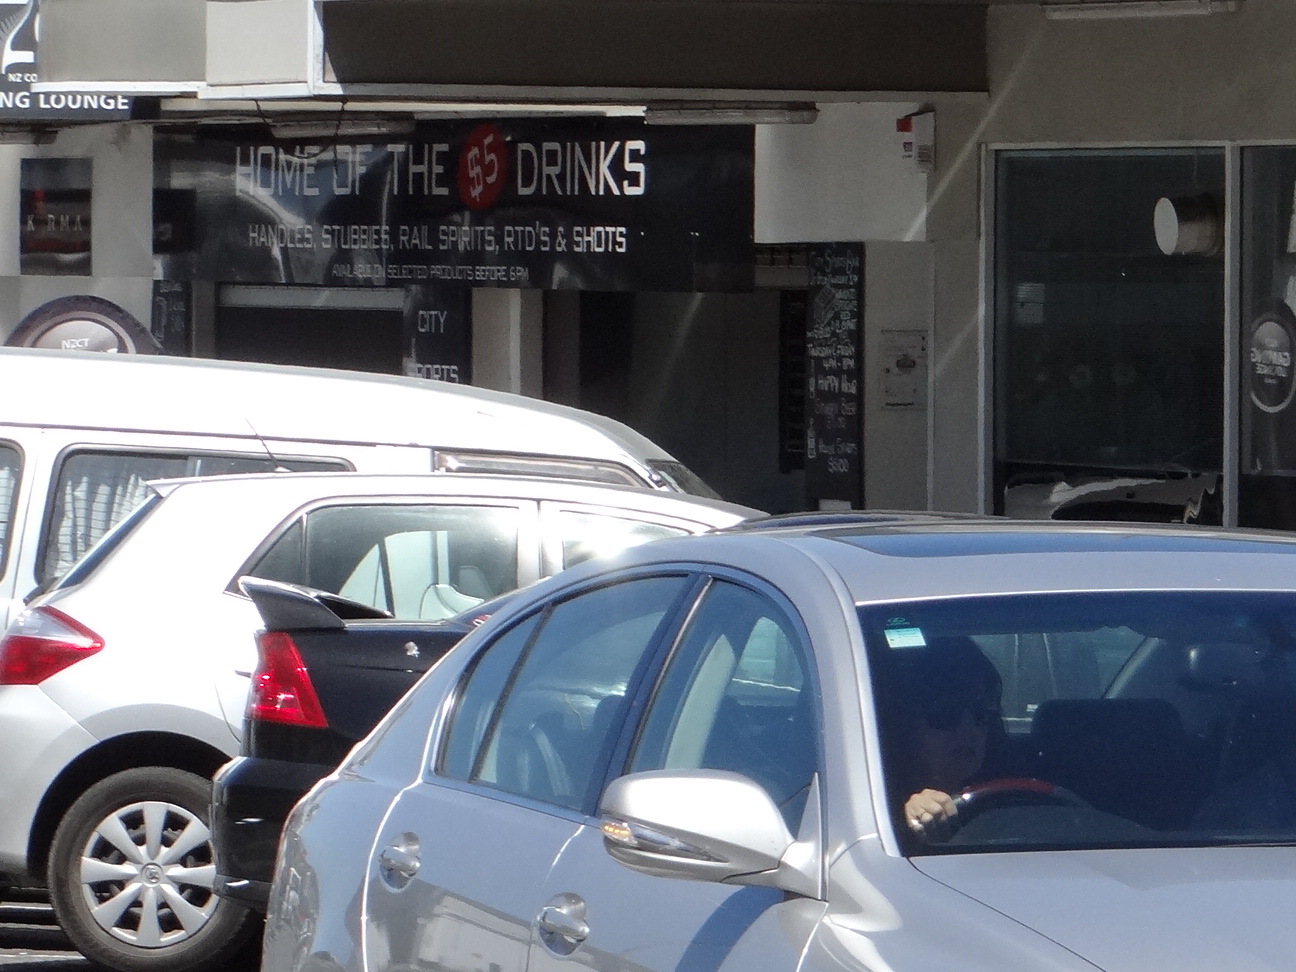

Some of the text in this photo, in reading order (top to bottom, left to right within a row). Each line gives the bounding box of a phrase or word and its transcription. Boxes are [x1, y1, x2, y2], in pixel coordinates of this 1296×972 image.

[8, 73, 22, 82] NZ
[39, 93, 130, 110] LOUNGE
[236, 133, 646, 202] HOME OF THE $5 DRINKS
[249, 221, 627, 254] HANDLES, STUBBIES, RAIL SPIRITS, RTD'S & SHOTS
[418, 310, 448, 333] CITY
